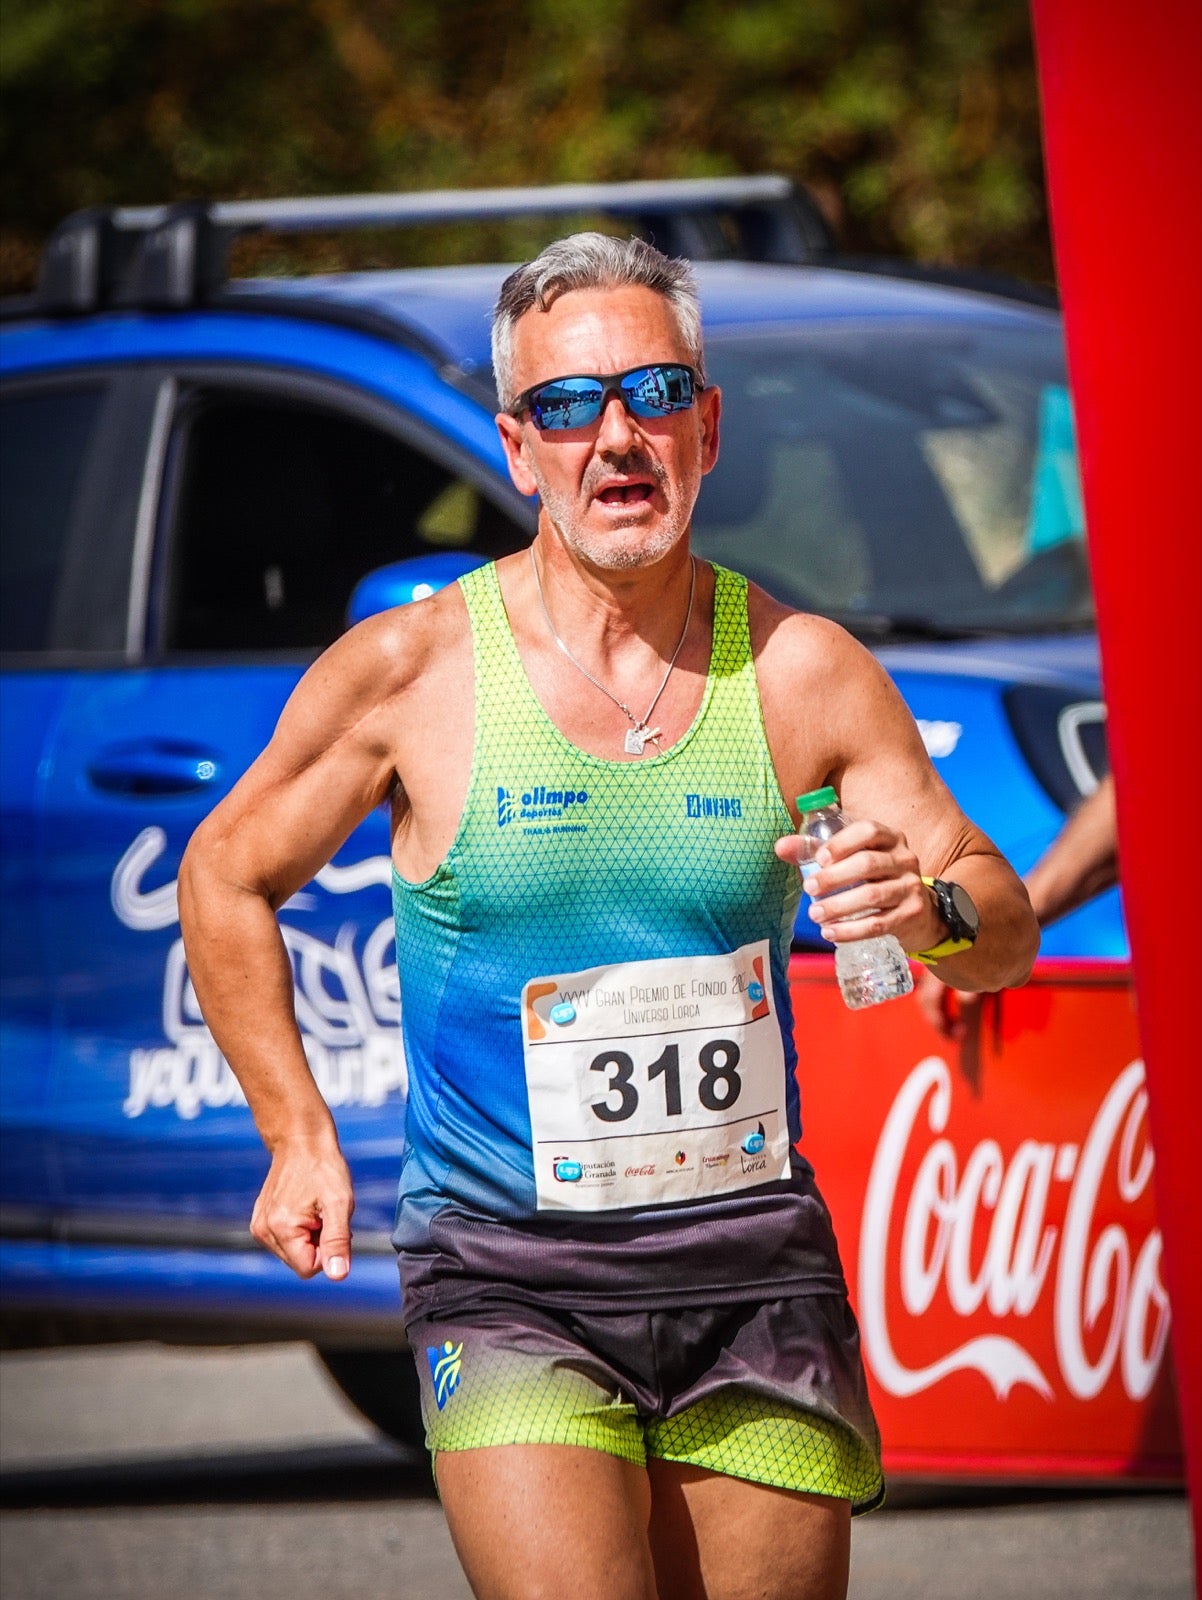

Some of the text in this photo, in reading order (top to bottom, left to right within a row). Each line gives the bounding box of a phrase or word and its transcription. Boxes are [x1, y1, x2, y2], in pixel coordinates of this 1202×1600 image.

[521, 786, 588, 808] olimpo
[595, 988, 625, 1008] GRAN
[630, 985, 670, 1007] PREMIO
[673, 983, 687, 1001] DE
[691, 979, 727, 999] FONDO
[623, 1003, 701, 1025] UNIVERSO LORCA
[589, 1039, 742, 1123] 318
[584, 1168, 617, 1179] Granada
[741, 1155, 767, 1174] Lorca
[857, 1054, 1171, 1401] Coca-Co
